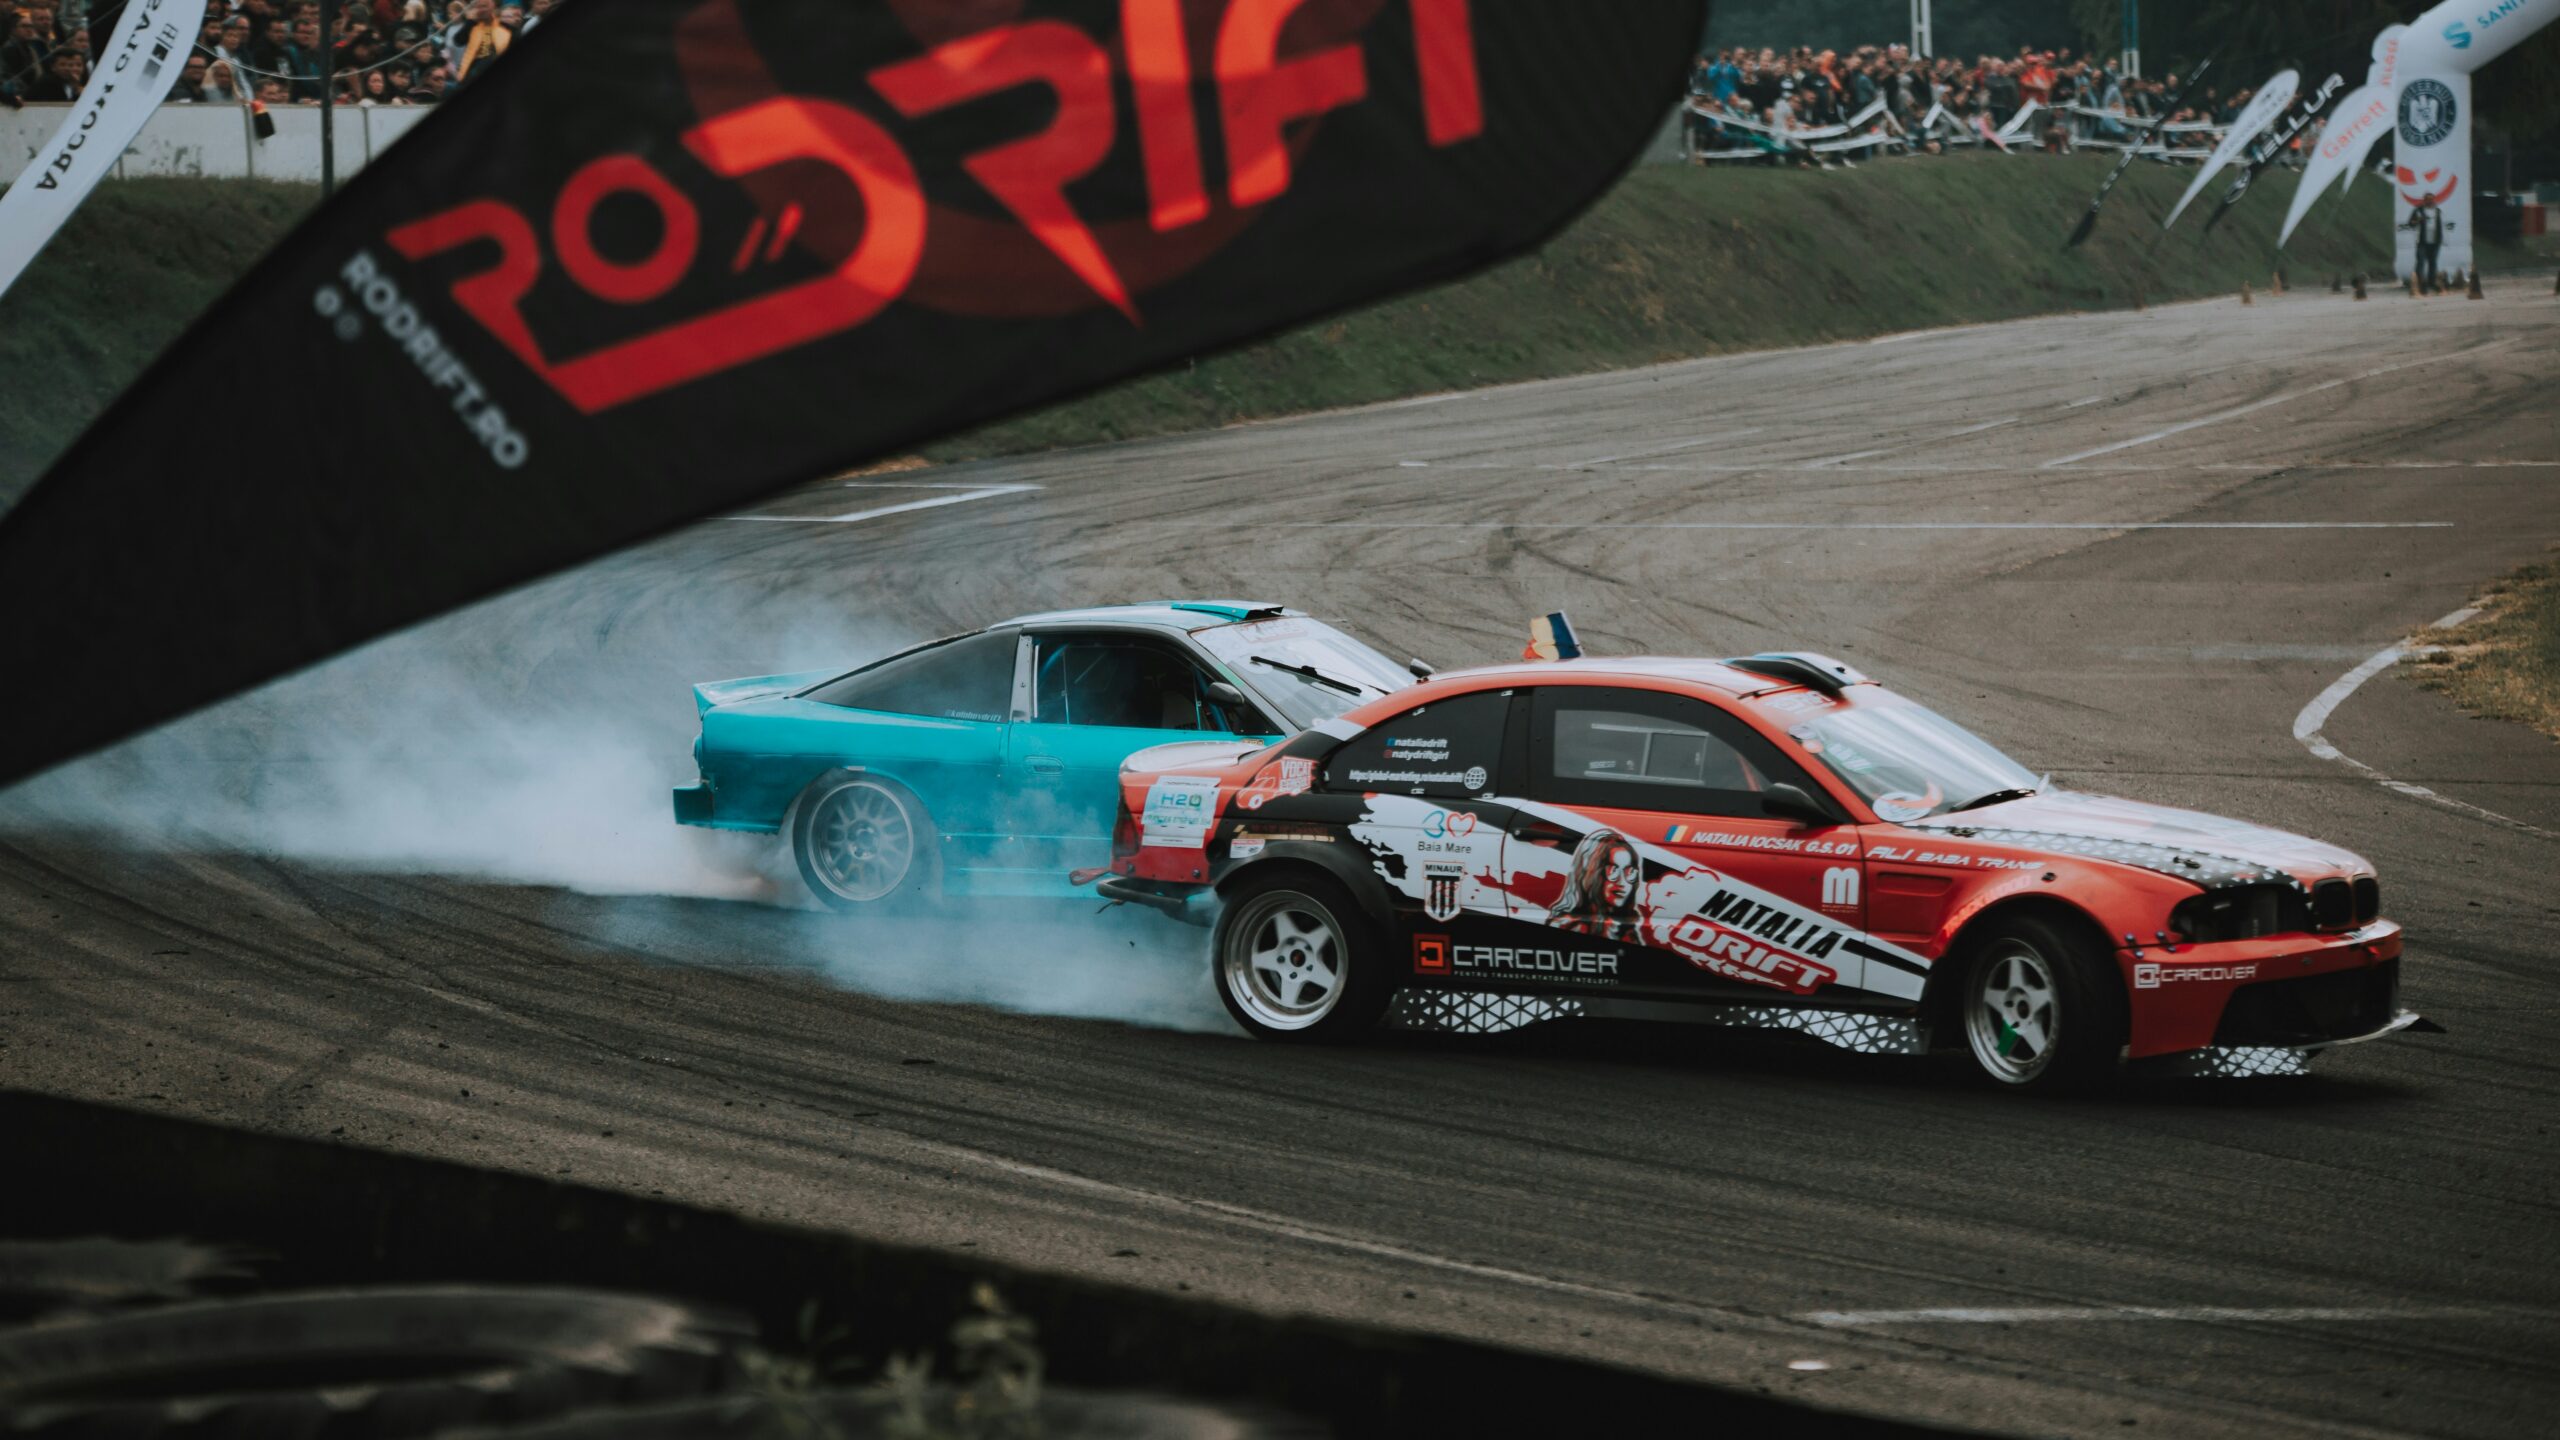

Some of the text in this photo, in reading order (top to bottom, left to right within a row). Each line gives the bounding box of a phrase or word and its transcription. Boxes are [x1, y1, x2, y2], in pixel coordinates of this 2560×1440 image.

[2322, 98, 2388, 159] Garrett
[1418, 841, 1472, 853] Baia Mare
[1691, 831, 1750, 847] NATALIA
[1425, 864, 1463, 873] MINAUR
[1866, 845, 2047, 870] ALI BABA TRANS
[1697, 889, 1843, 959] NATALIA
[1674, 920, 1830, 987] DRIFT
